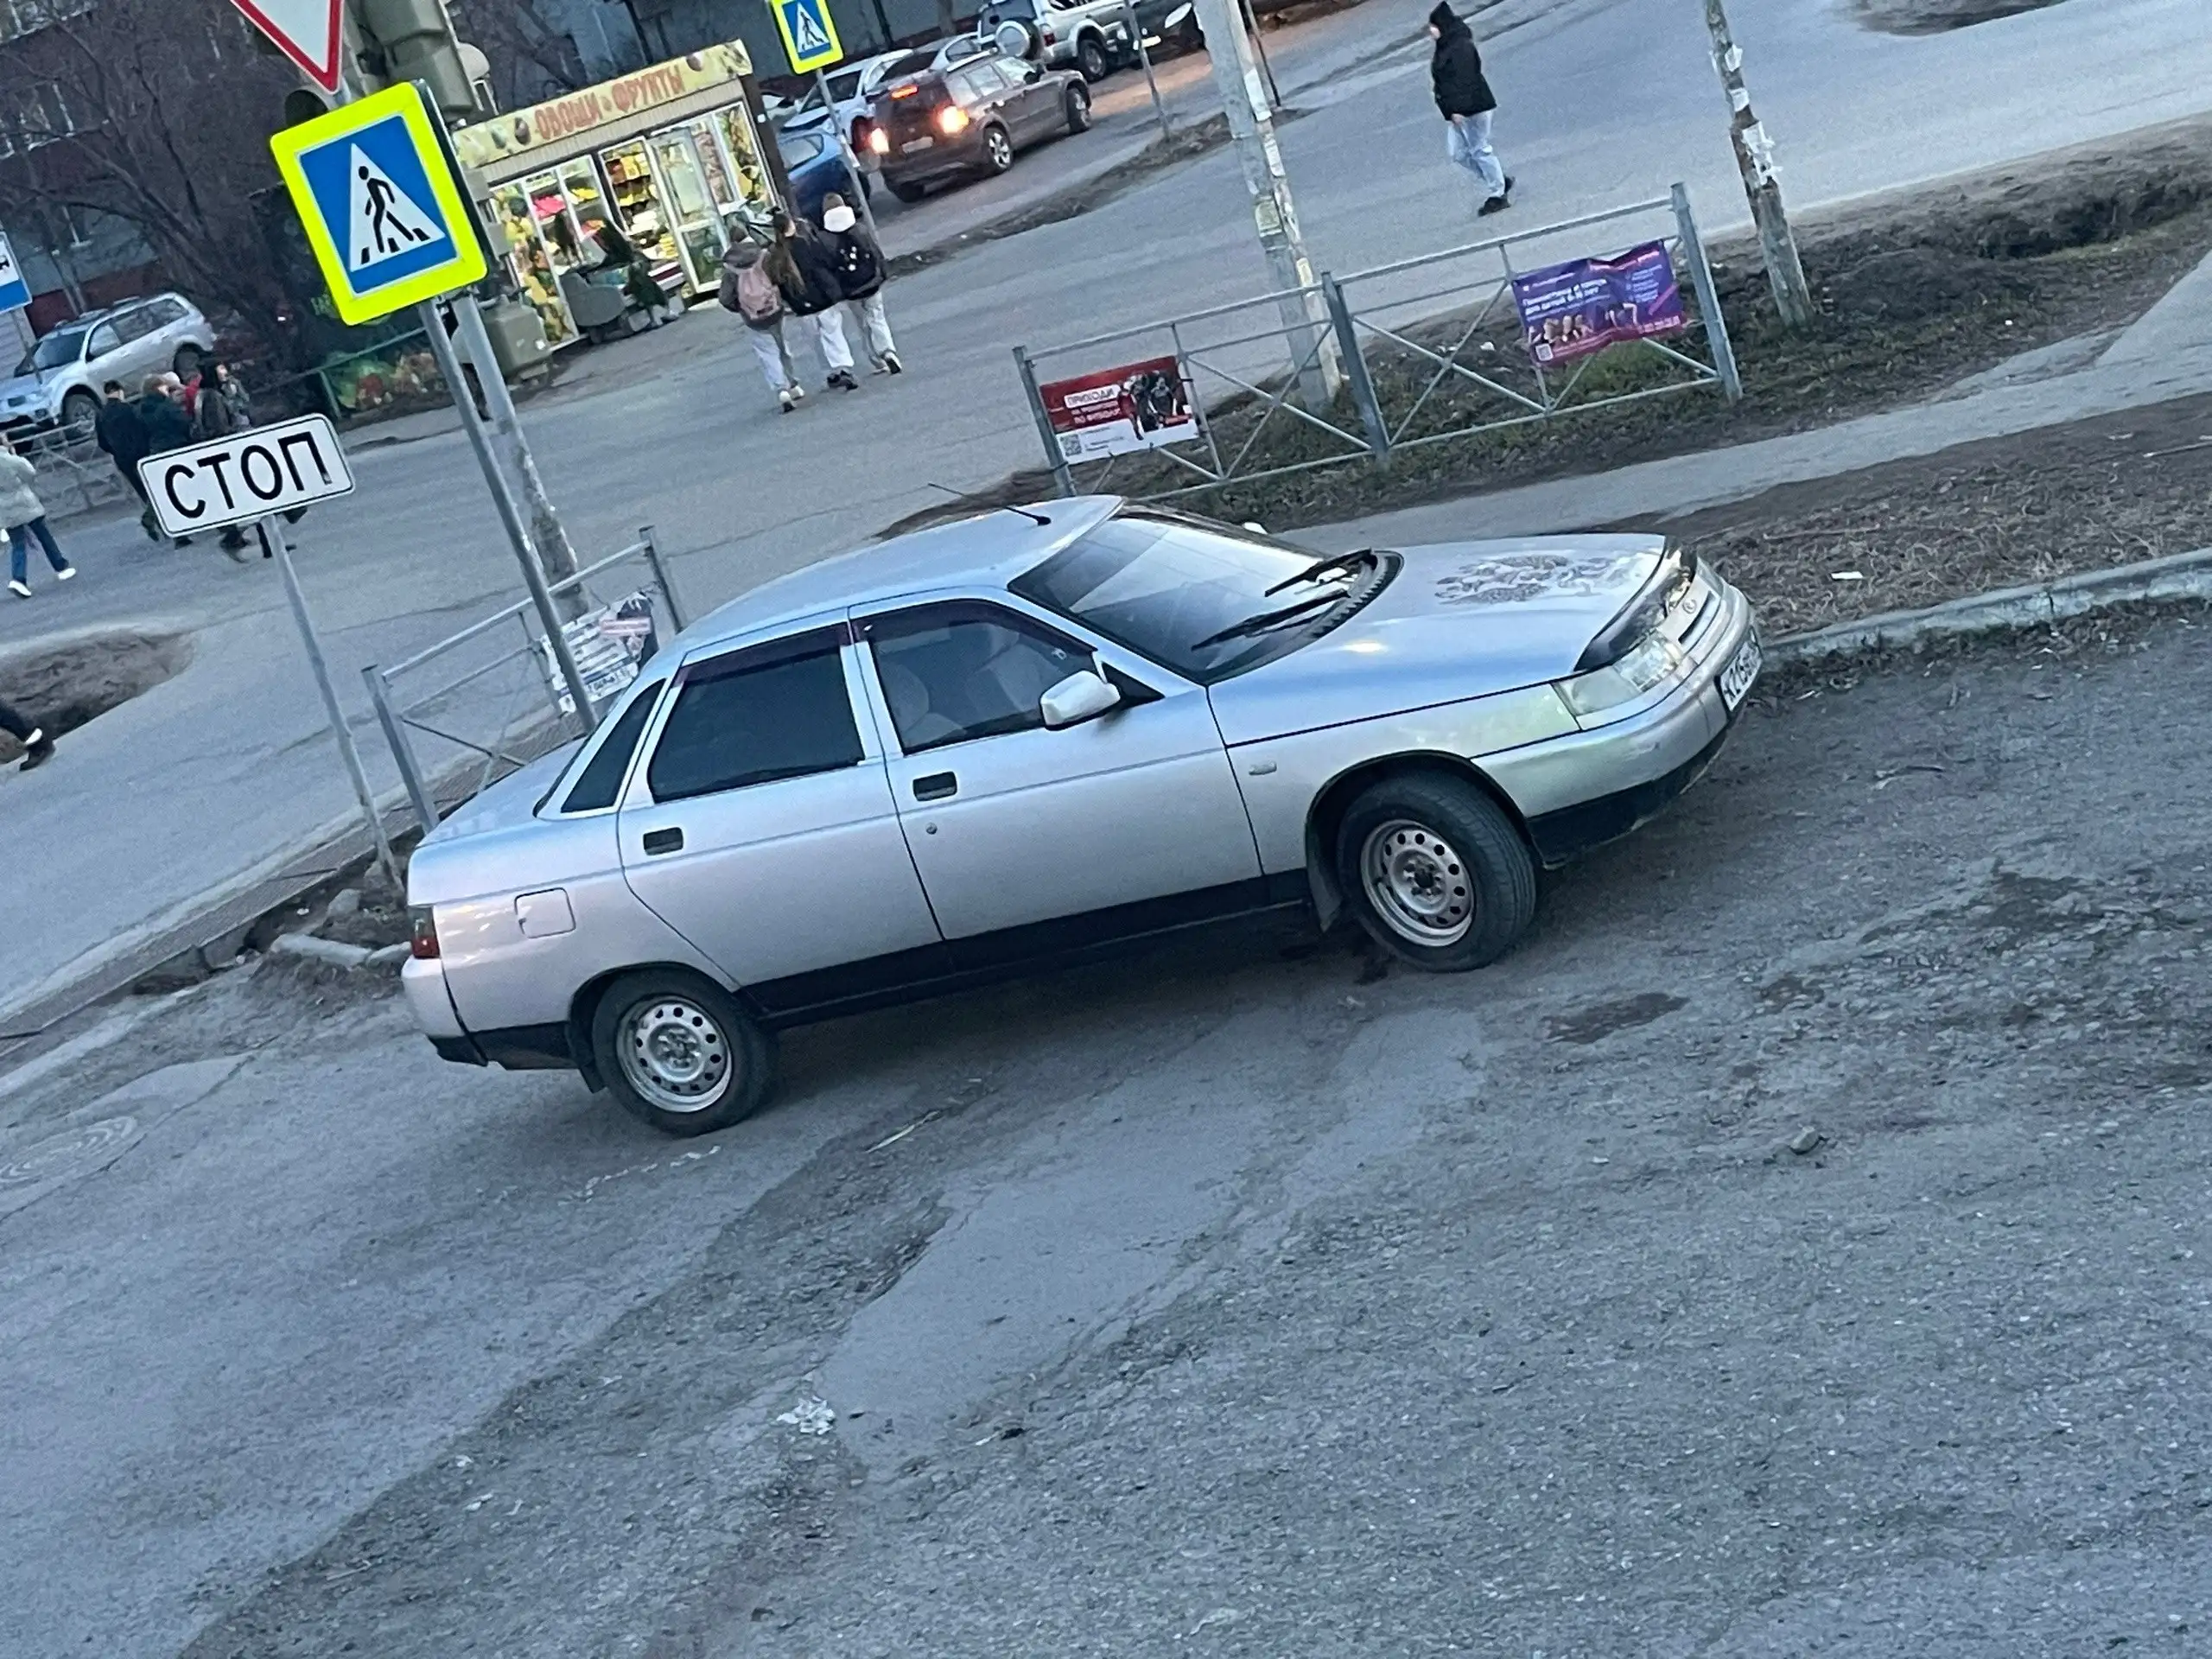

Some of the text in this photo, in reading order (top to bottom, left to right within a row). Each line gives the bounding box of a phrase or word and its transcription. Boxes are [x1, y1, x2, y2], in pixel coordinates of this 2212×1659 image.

[534, 64, 685, 140] ОВОЩИ ФРУКТЫ
[1067, 388, 1116, 406] ПРИХОДИ
[165, 431, 333, 518] СТОП
